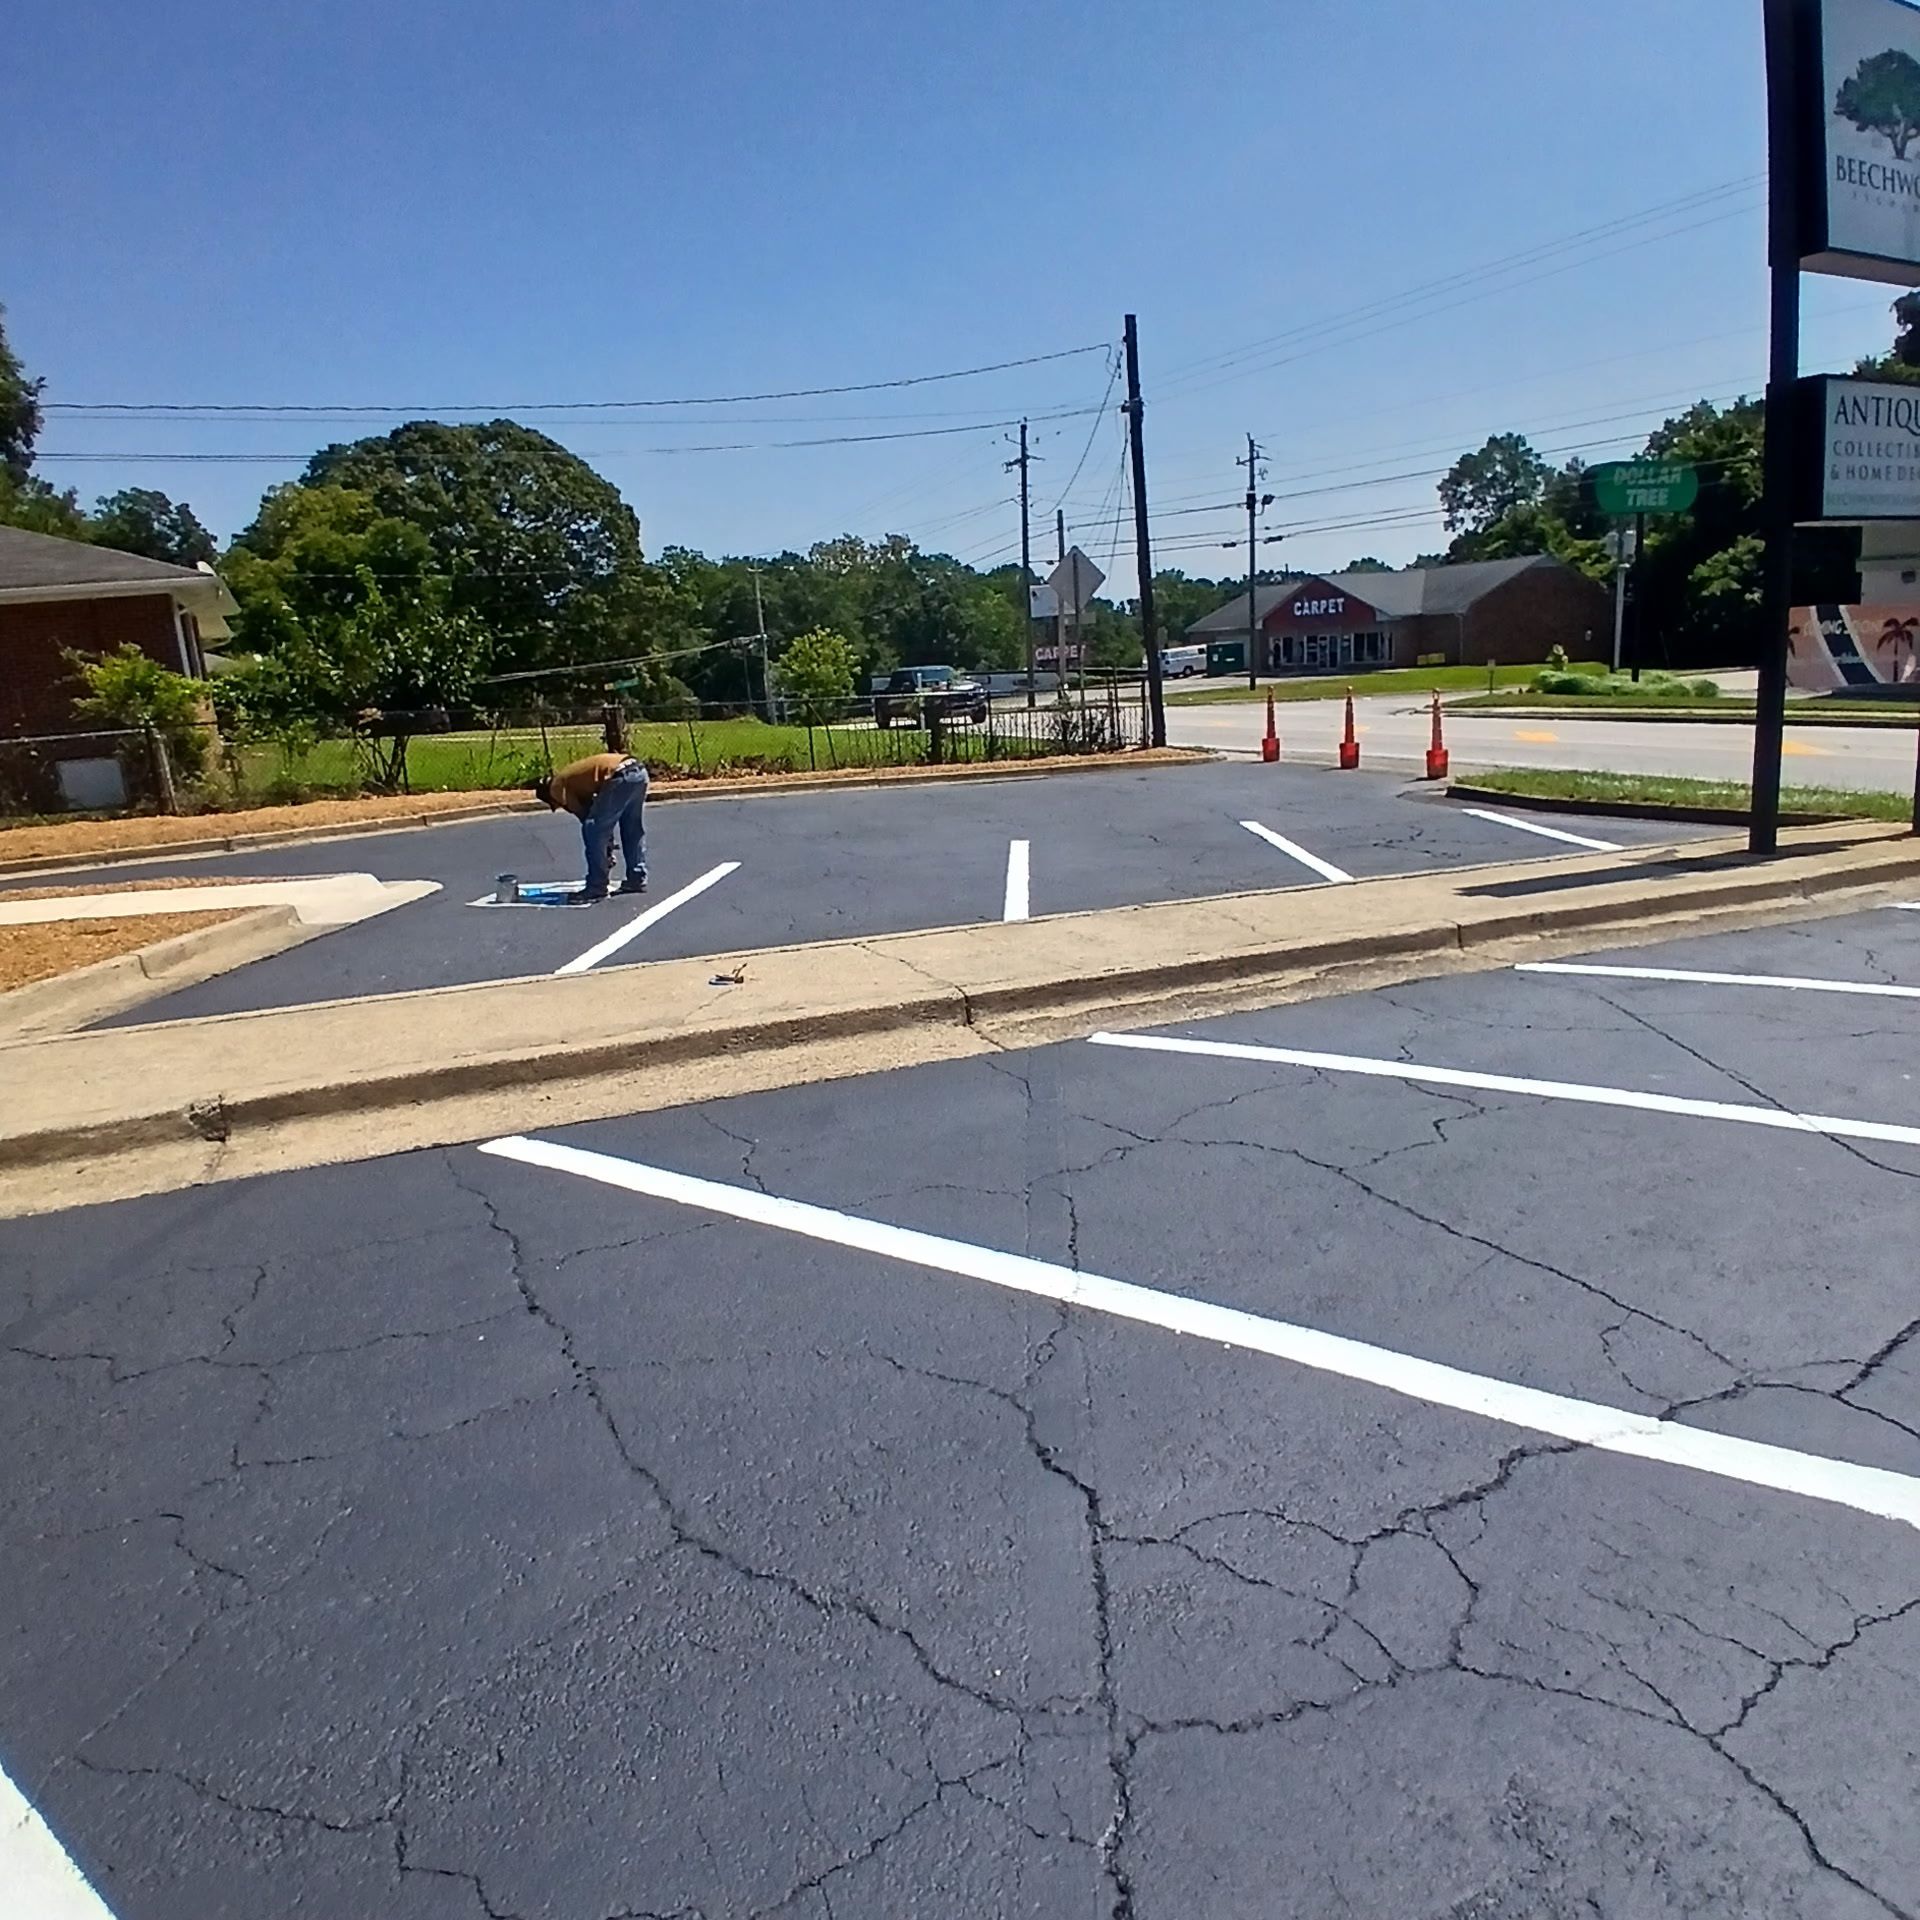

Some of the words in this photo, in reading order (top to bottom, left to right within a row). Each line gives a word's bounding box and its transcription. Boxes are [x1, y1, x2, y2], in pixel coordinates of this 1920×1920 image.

[1613, 466, 1682, 486] DOLLAR
[1831, 464, 1839, 480] &
[1846, 465, 1892, 480] HOME
[1626, 488, 1669, 506] TREE
[1294, 598, 1345, 616] CARPET
